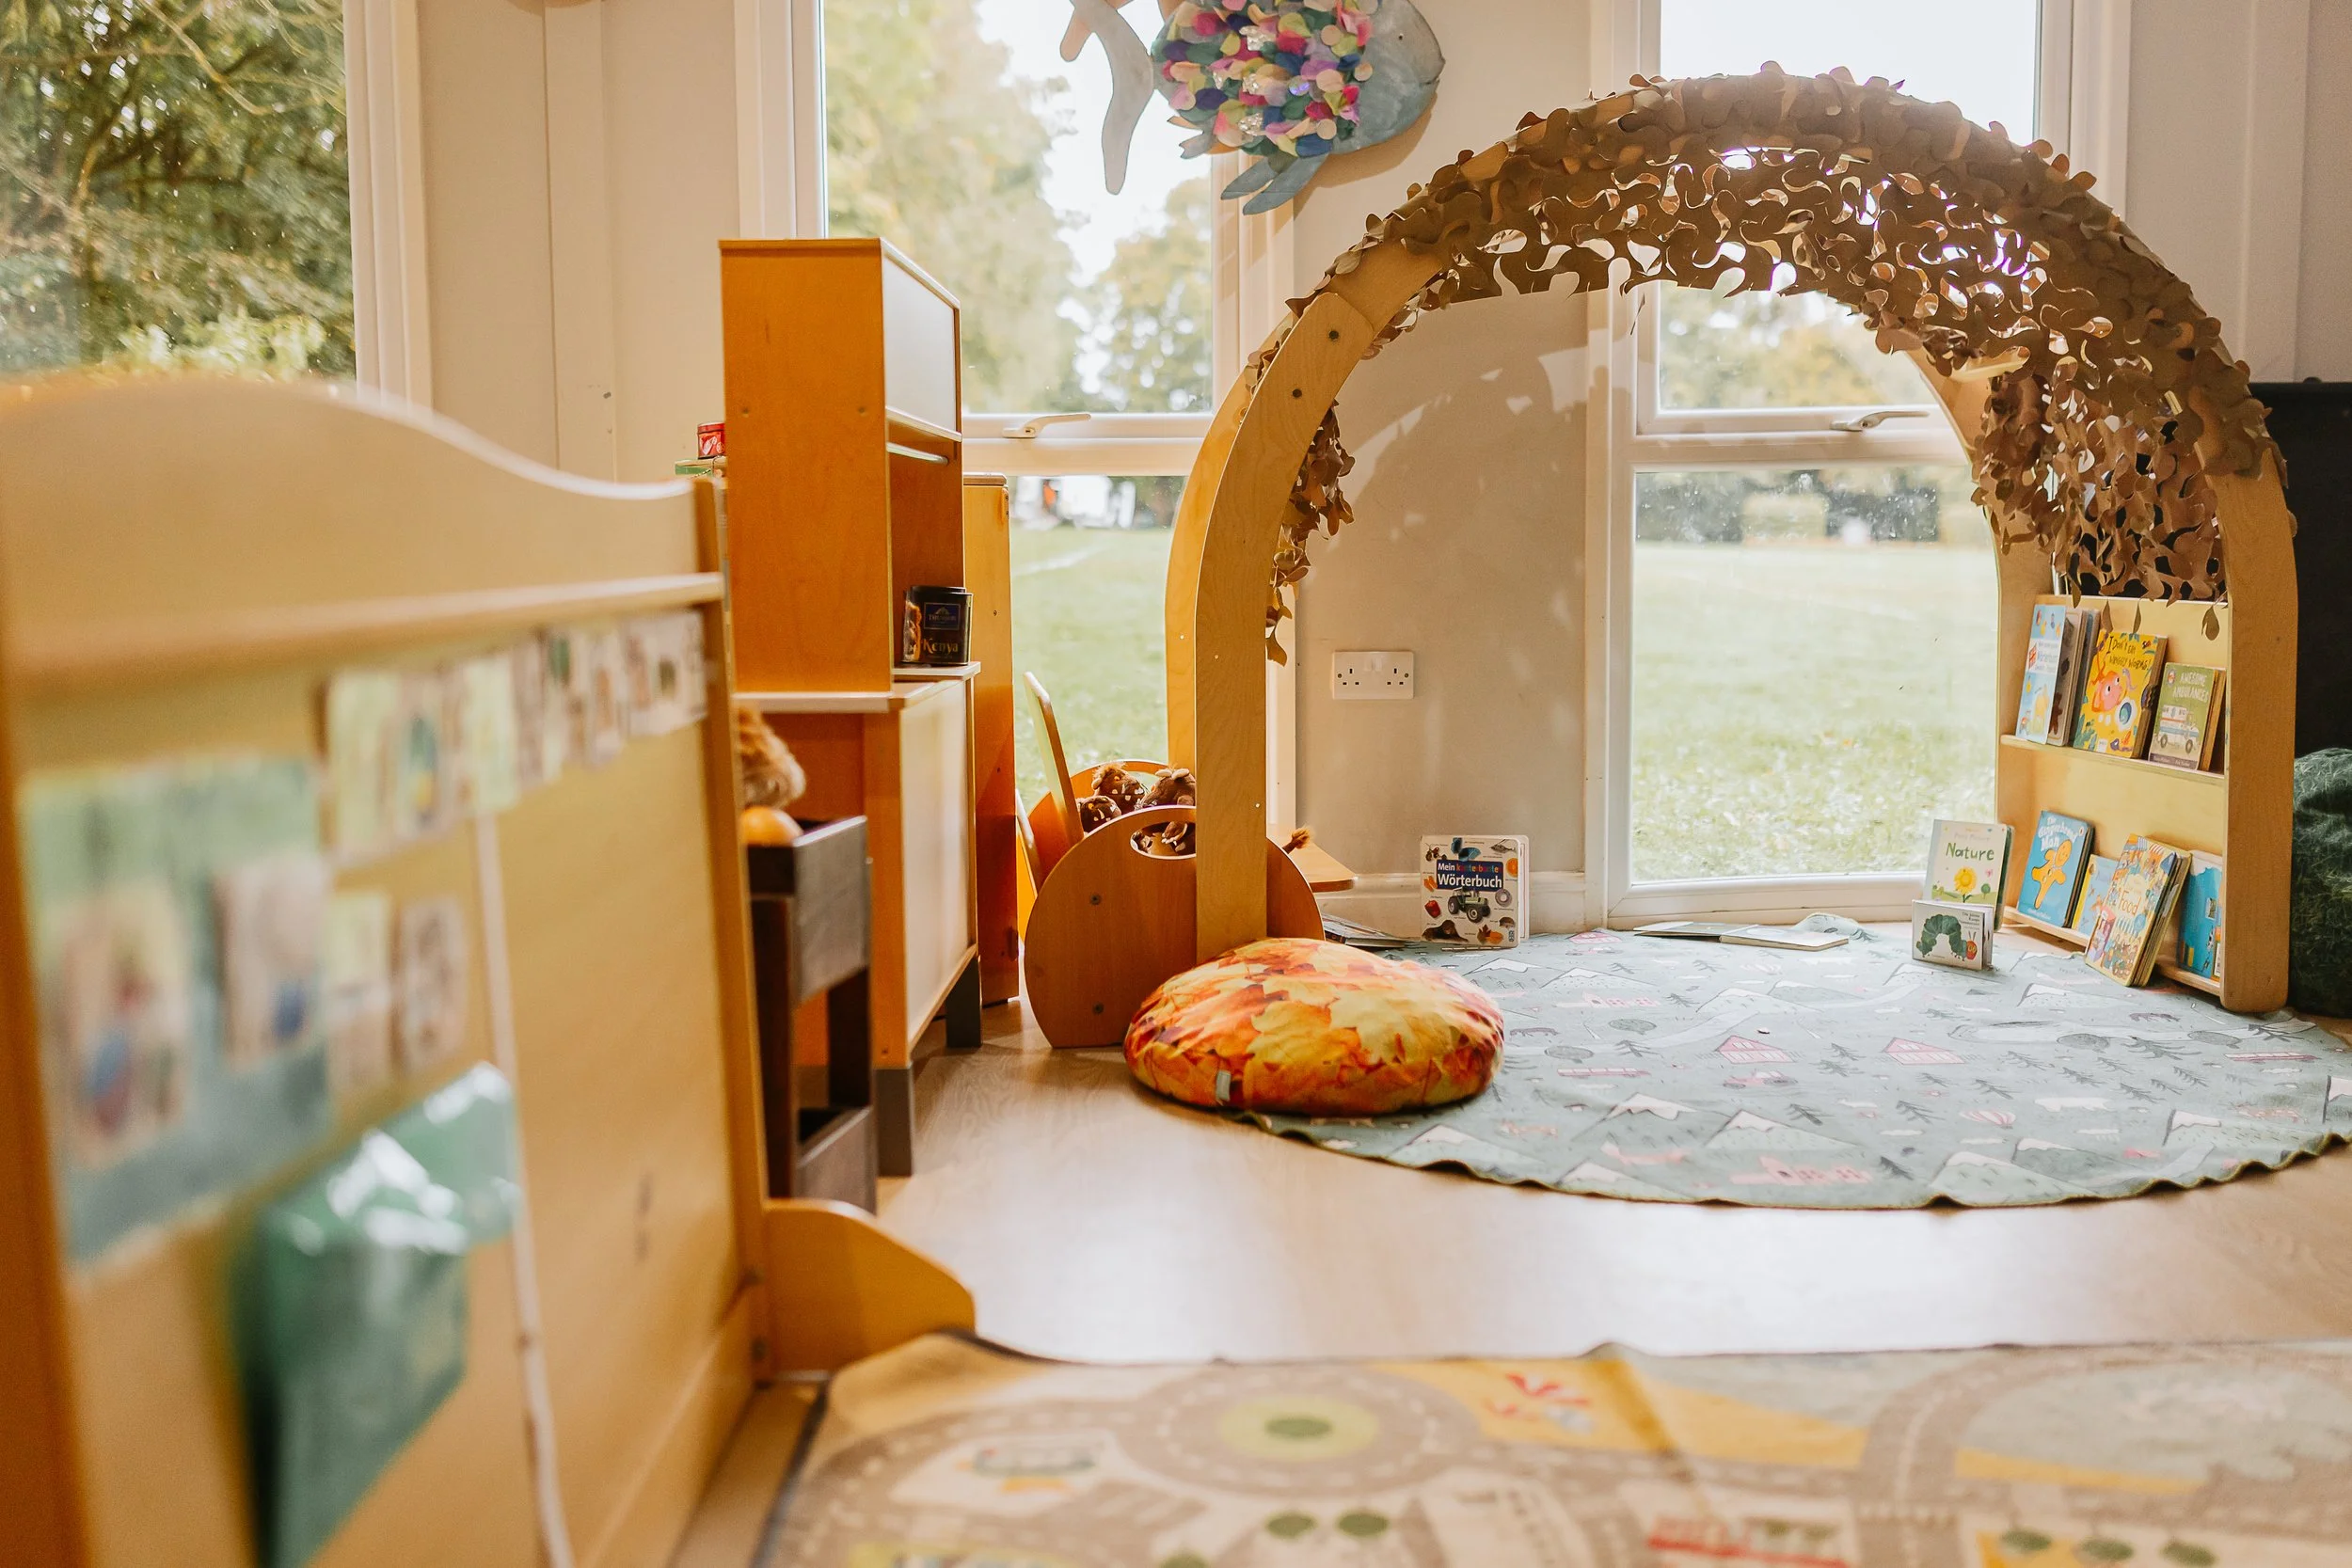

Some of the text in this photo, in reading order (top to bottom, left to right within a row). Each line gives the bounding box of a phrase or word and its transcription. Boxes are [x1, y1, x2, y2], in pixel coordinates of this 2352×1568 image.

[923, 638, 959, 655] Kenya
[2041, 835, 2060, 851] Man
[1946, 842, 1994, 861] Nature
[1438, 863, 1455, 871] Mein
[1437, 873, 1502, 888] Wörterbuch
[2121, 889, 2142, 916] Food
